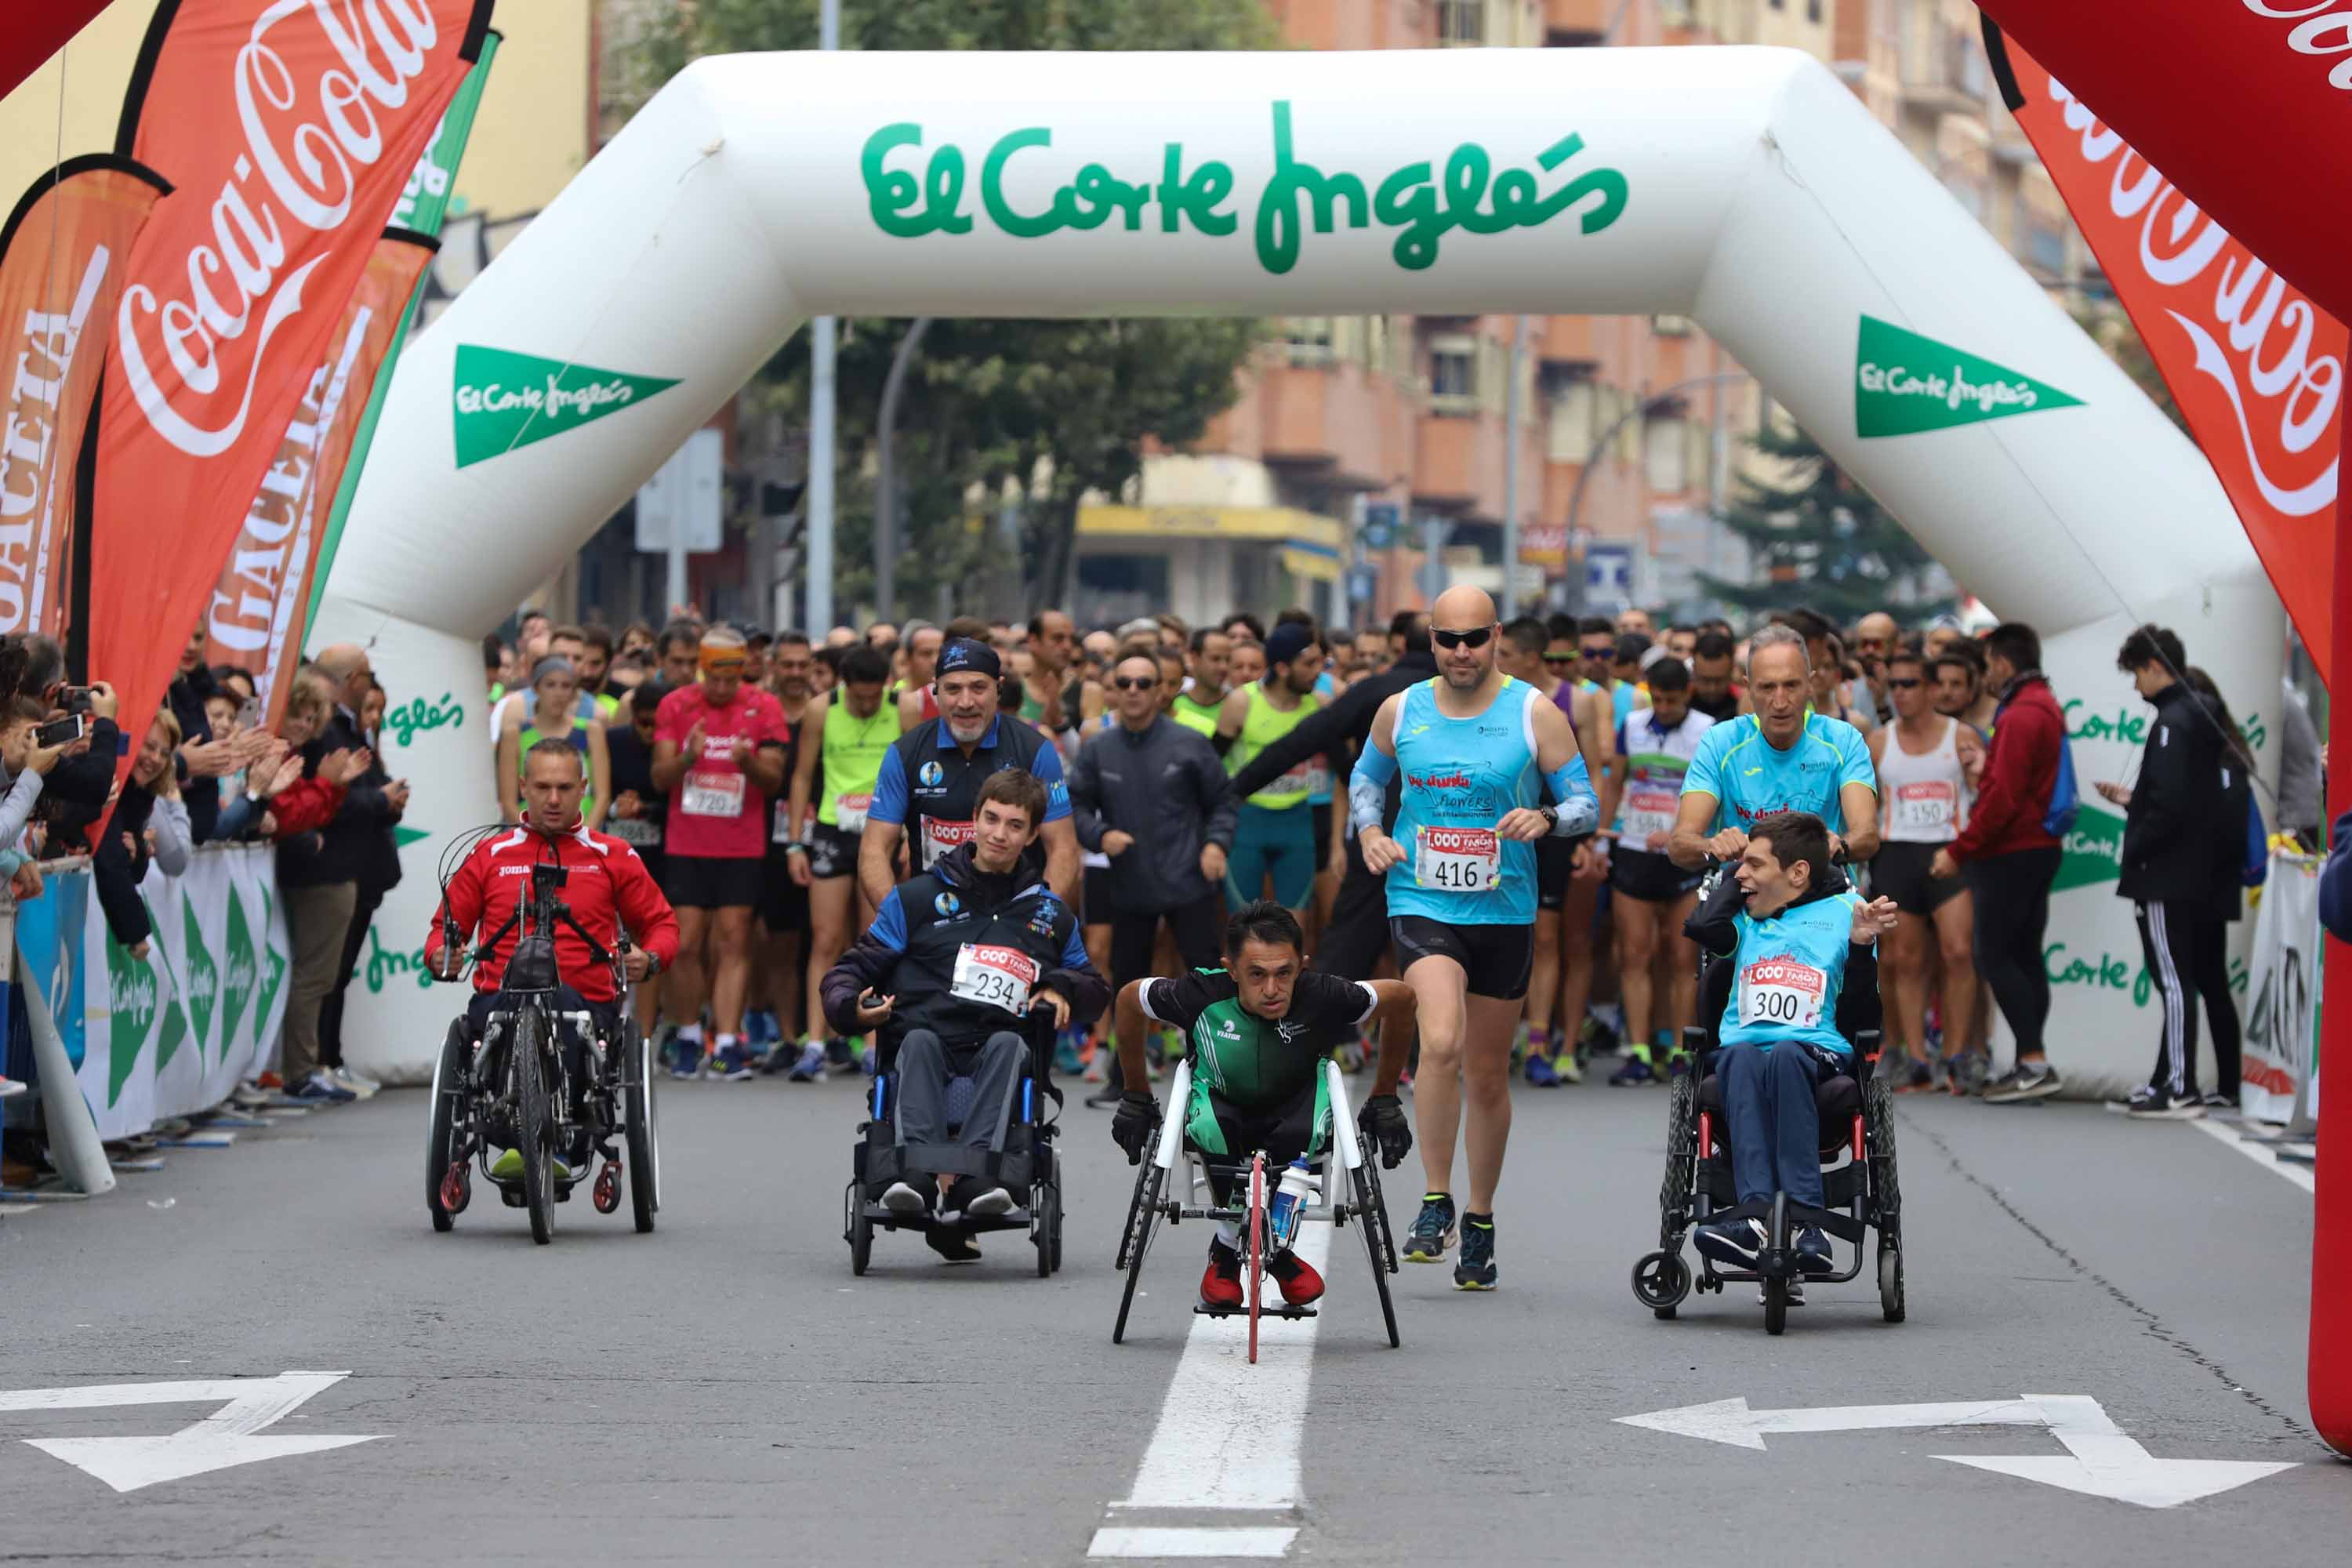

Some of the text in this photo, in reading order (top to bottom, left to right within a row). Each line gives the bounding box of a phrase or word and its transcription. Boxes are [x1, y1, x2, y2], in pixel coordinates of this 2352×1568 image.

[862, 100, 1629, 274] El Corte Inglés
[456, 373, 633, 419] El Corte Inglés
[1859, 363, 2038, 412] El Corte Inglés
[2063, 699, 2147, 745] Corte
[1435, 861, 1478, 887] 416
[2044, 942, 2129, 989] Corte
[974, 972, 1015, 1006] 234
[1753, 991, 1798, 1021] 300
[1217, 1029, 1241, 1041] VIATOR
